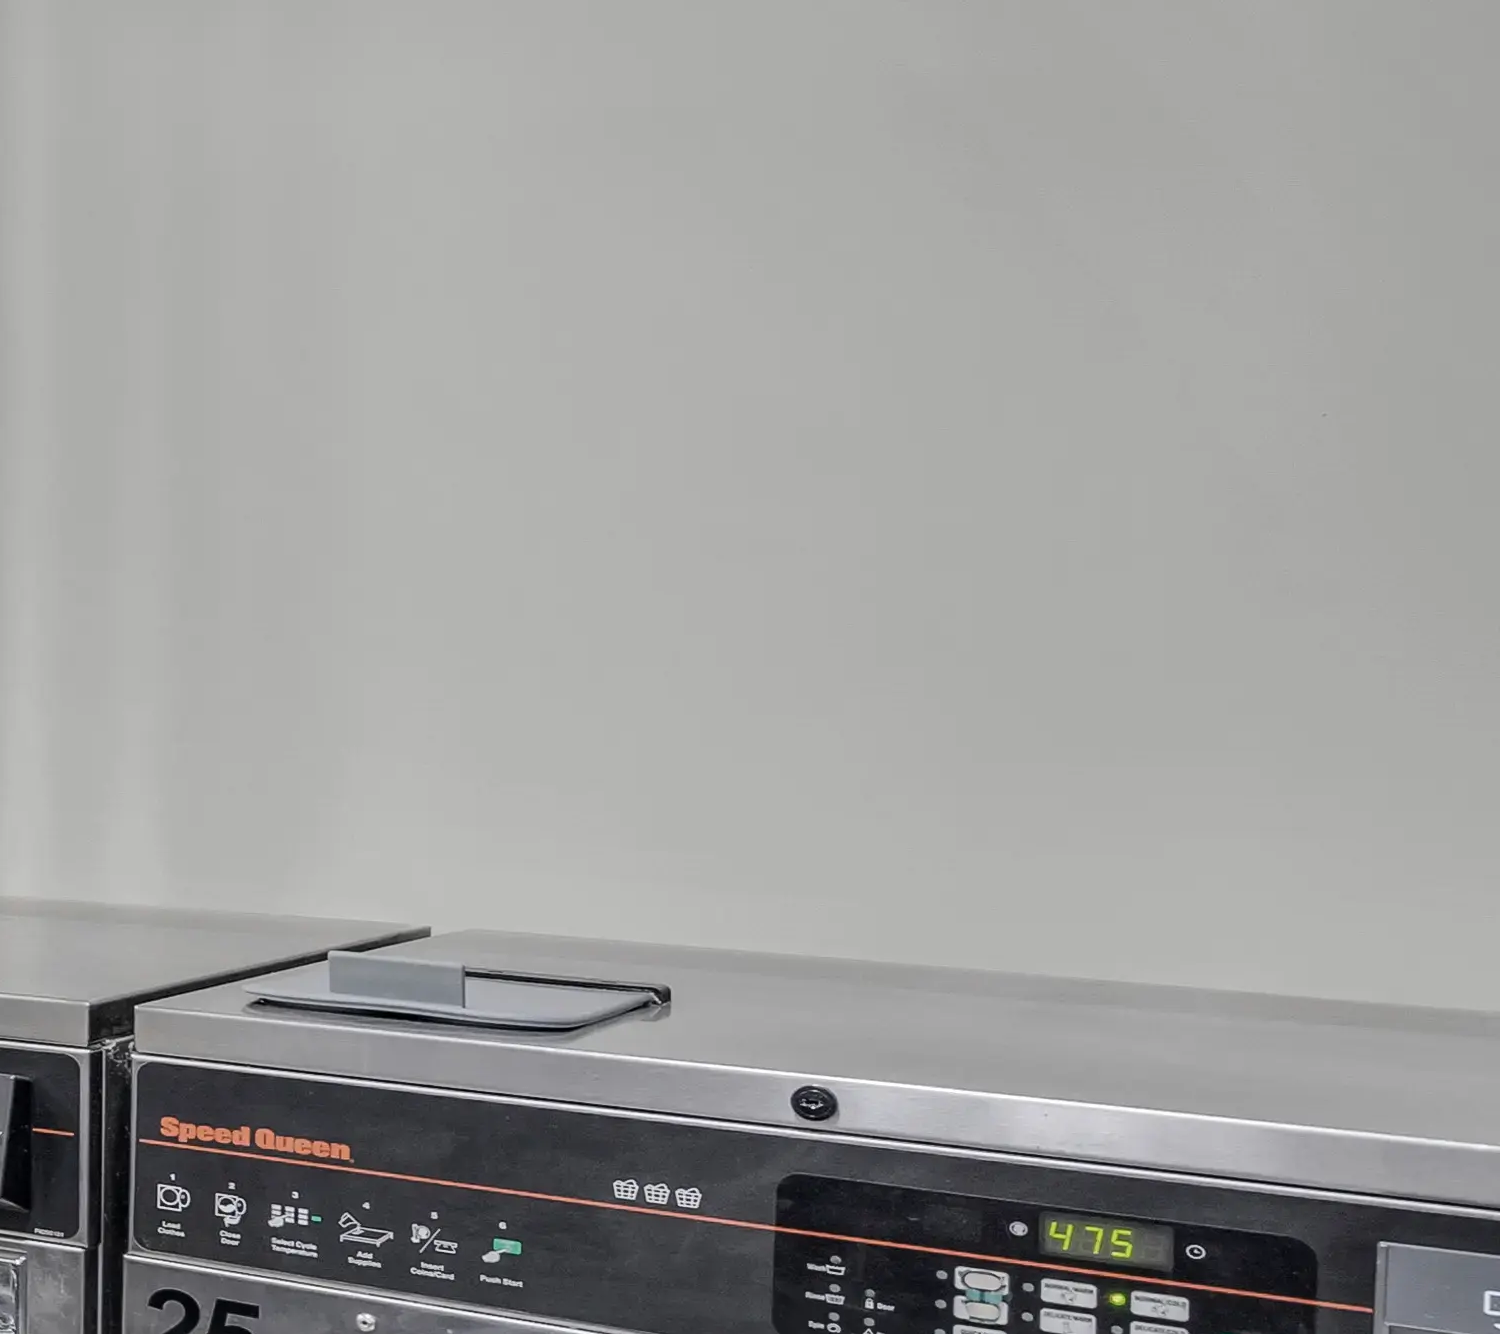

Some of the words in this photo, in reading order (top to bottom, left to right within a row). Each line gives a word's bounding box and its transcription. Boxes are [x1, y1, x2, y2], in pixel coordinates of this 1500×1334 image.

[159, 1115, 251, 1150] Speed
[254, 1127, 353, 1162] Queen
[169, 1173, 176, 1181] 1
[228, 1182, 235, 1190] 2
[291, 1191, 299, 1199] 3
[362, 1201, 371, 1209] 4
[430, 1211, 438, 1219] 5
[162, 1220, 181, 1230] Load
[157, 1228, 186, 1238] Clothes
[219, 1230, 241, 1239] Close
[220, 1237, 240, 1247] Door
[271, 1237, 295, 1247] Select
[295, 1241, 317, 1251] Cycle
[1049, 1221, 1134, 1259] 475
[271, 1244, 318, 1258] Temperature
[356, 1251, 373, 1259] Add
[348, 1256, 382, 1268] Supplies
[420, 1262, 445, 1272] Insert
[410, 1267, 455, 1281] Coins/Card
[479, 1274, 501, 1285] Push
[502, 1278, 523, 1288] Start
